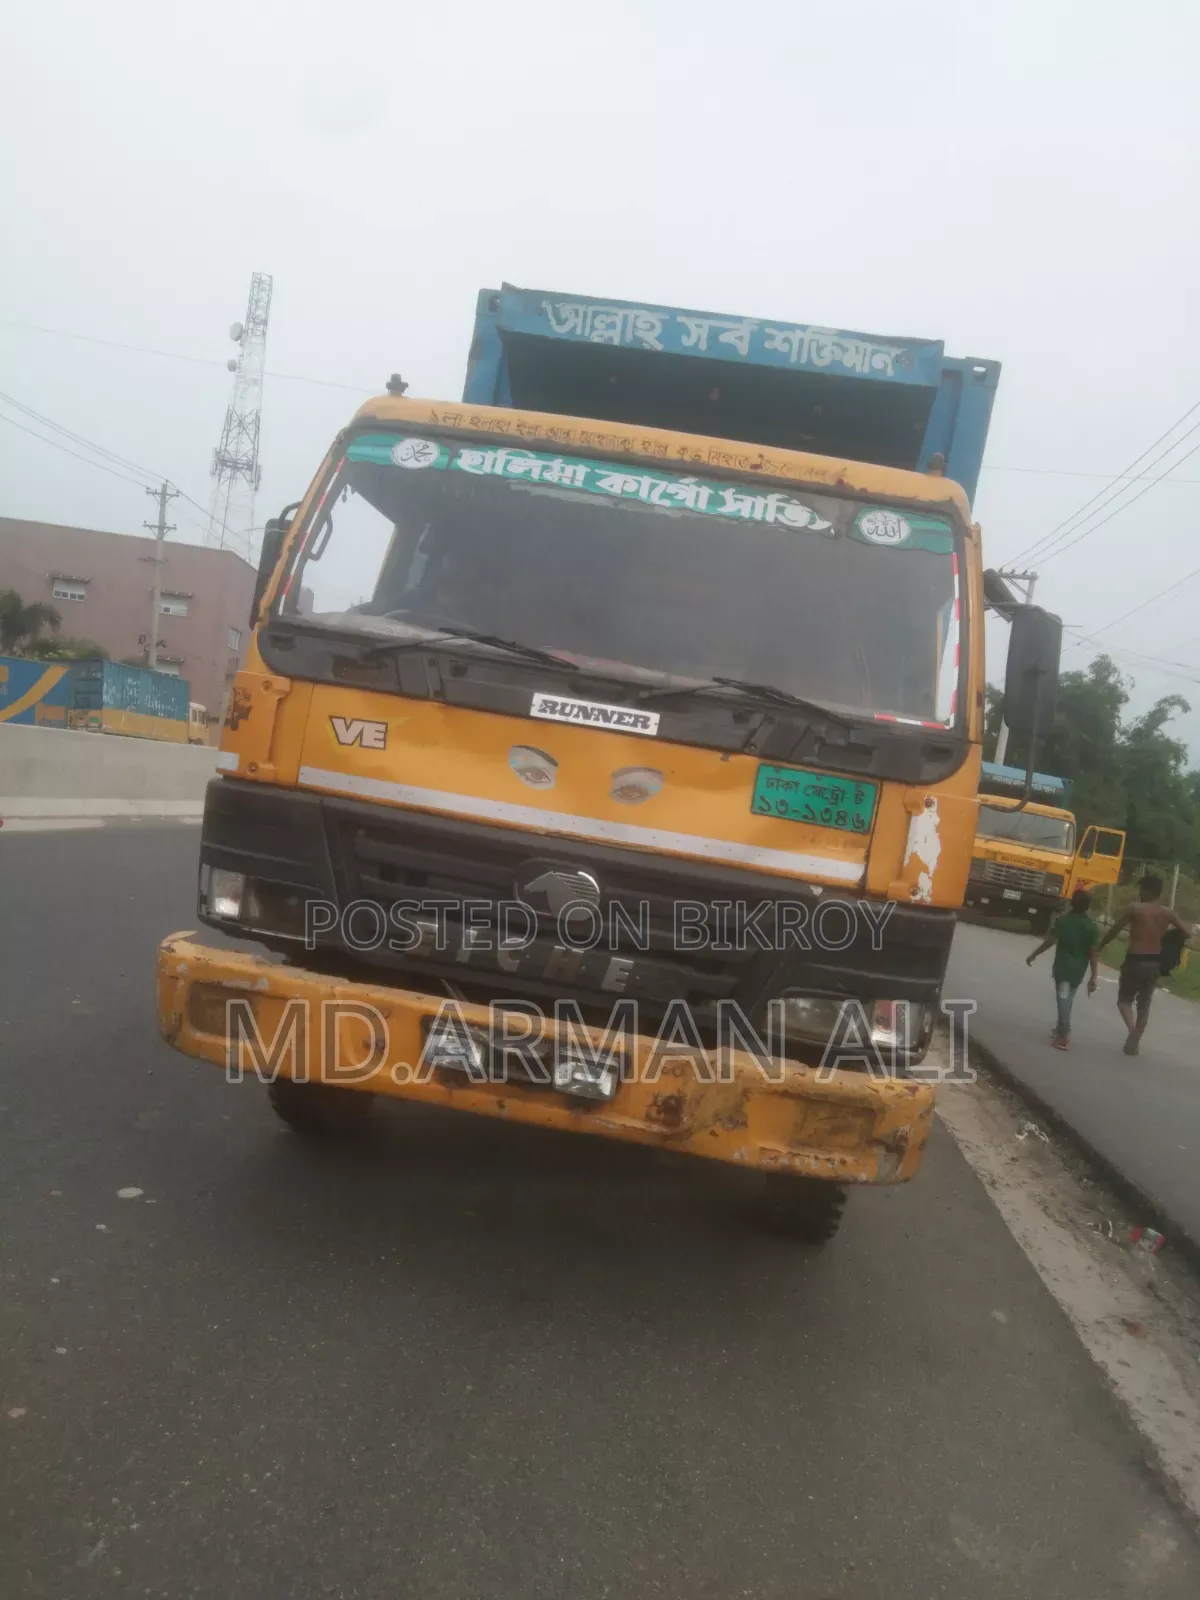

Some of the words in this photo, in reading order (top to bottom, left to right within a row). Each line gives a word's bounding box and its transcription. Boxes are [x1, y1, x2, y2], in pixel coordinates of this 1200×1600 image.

[538, 698, 651, 730] RUNNER
[328, 715, 388, 750] VE
[765, 776, 800, 793] ঢাকা
